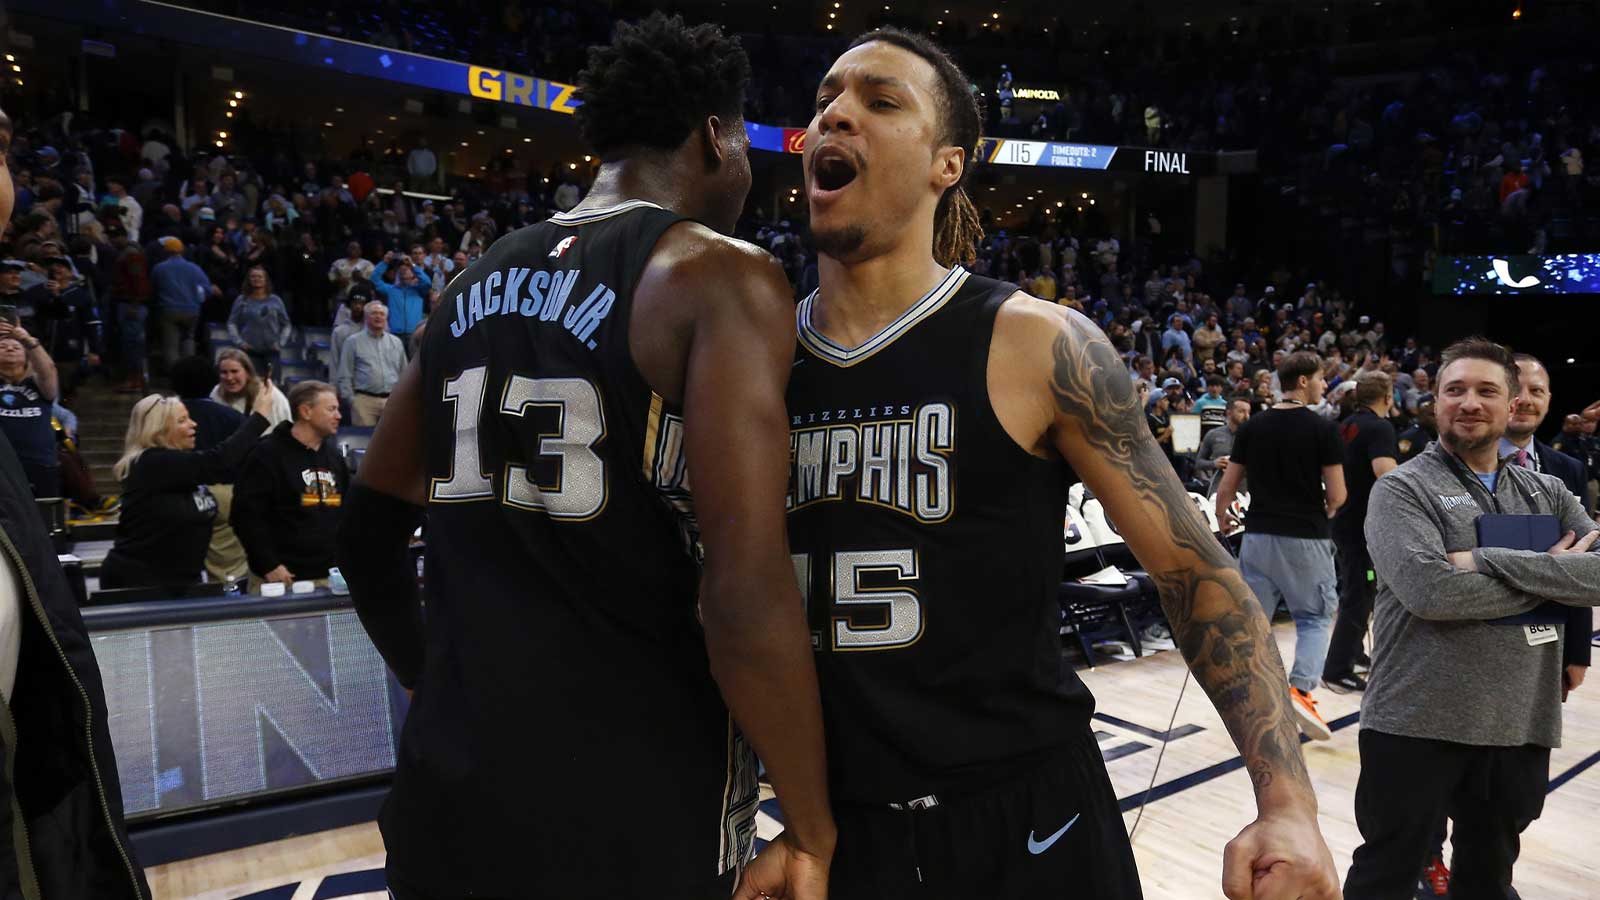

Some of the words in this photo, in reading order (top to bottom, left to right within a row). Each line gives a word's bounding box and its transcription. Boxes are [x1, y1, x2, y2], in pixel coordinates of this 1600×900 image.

[468, 64, 579, 115] GRIZ
[1017, 88, 1060, 101] MINOLTA
[1010, 143, 1031, 164] 115
[1051, 155, 1076, 166] FOULS:
[1052, 145, 1091, 157] TIMEOUTS:
[1144, 150, 1190, 174] FINAL
[450, 267, 581, 338] JACKSON
[563, 283, 617, 351] JR.
[429, 365, 609, 522] 13
[787, 402, 956, 524] MPHIS
